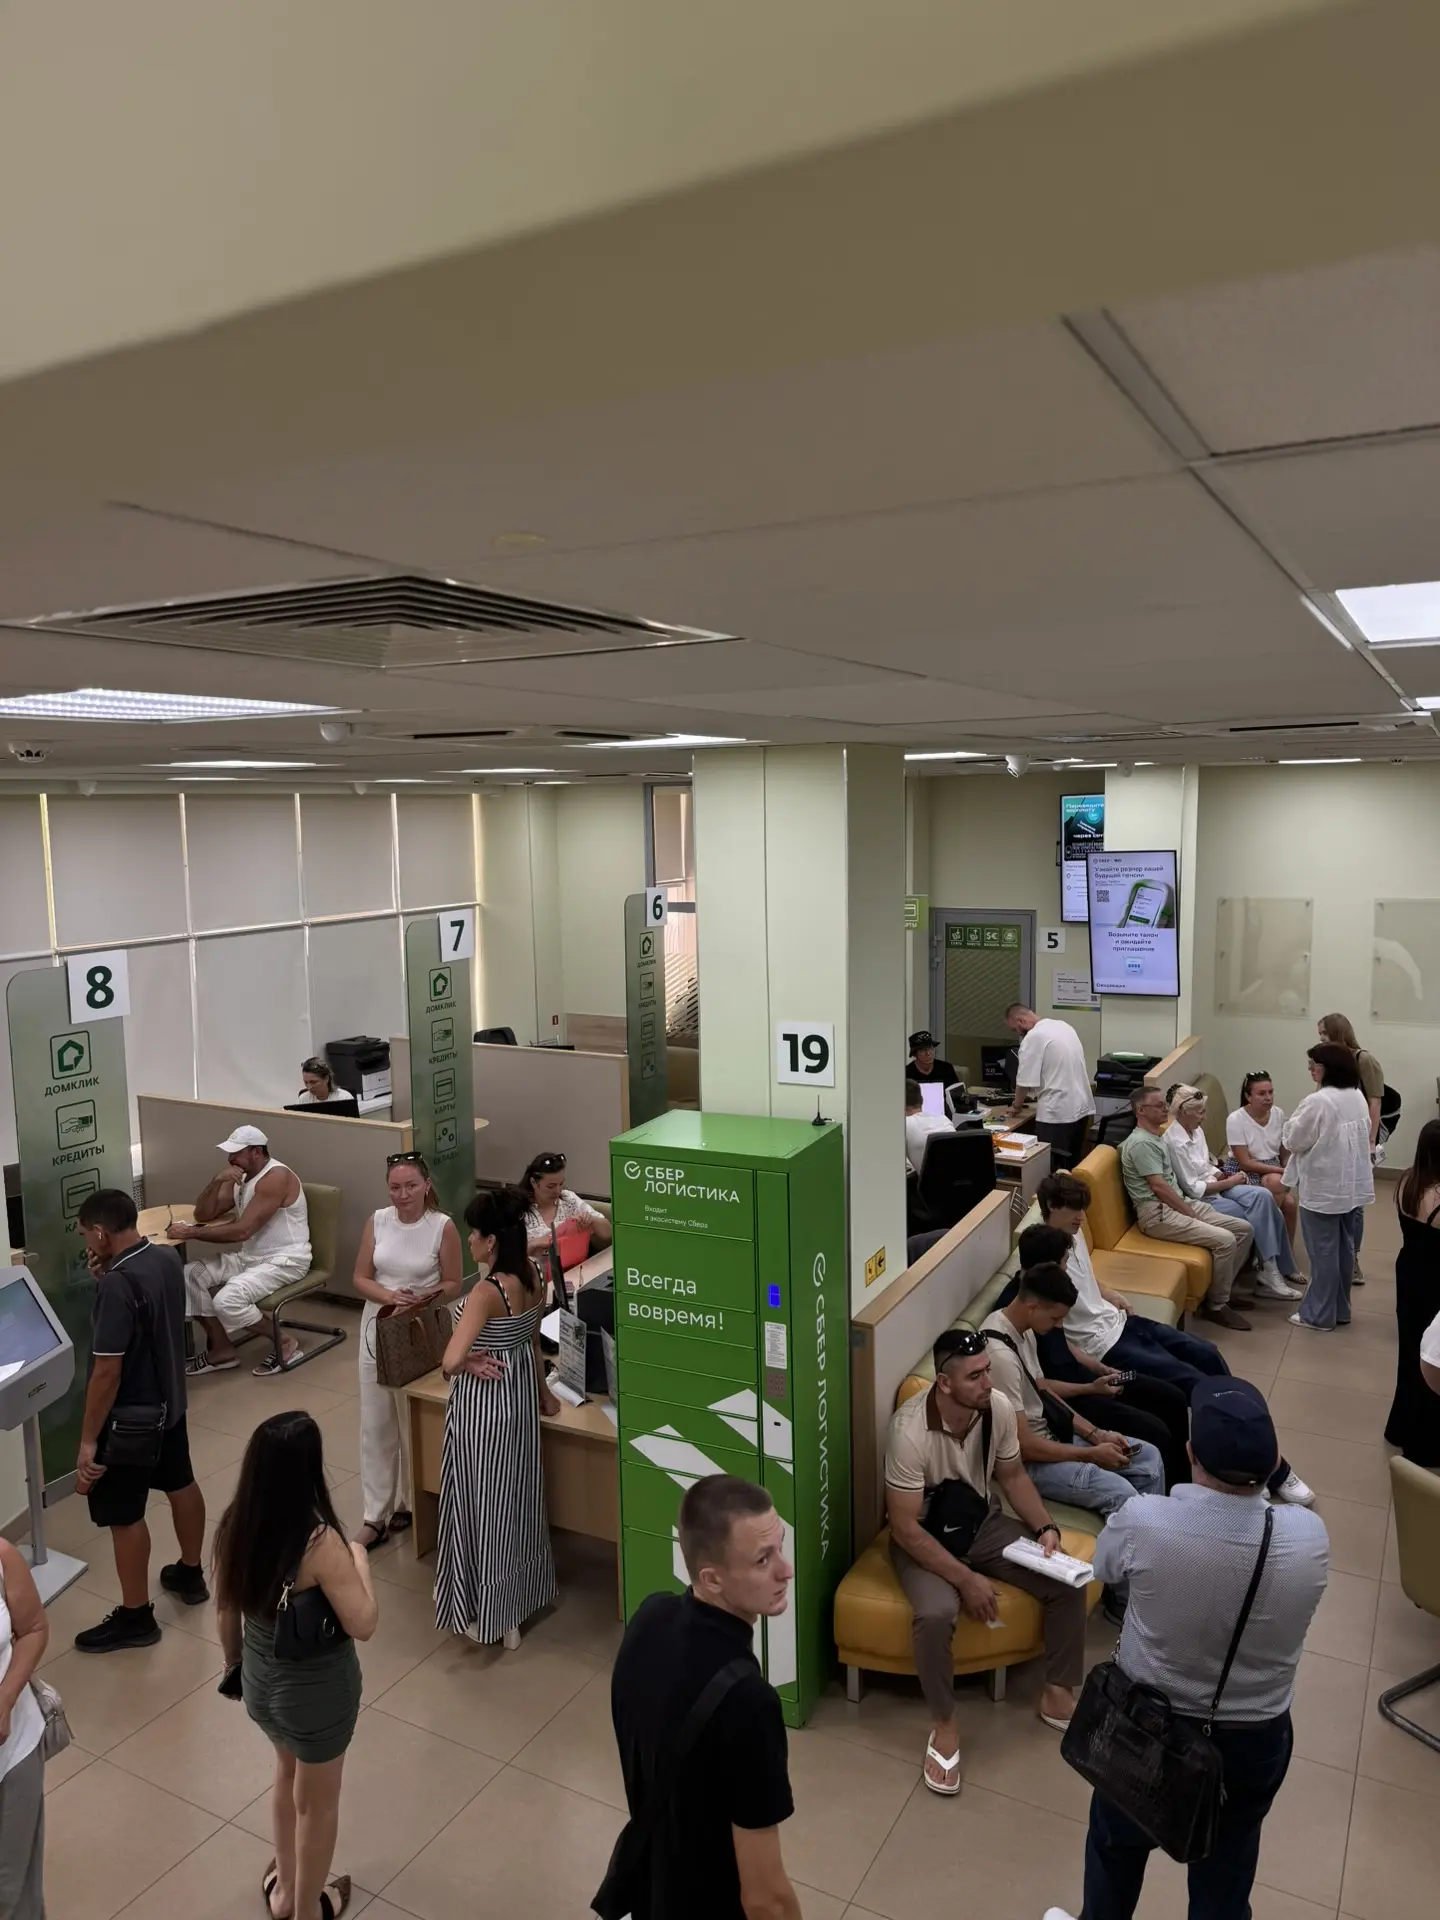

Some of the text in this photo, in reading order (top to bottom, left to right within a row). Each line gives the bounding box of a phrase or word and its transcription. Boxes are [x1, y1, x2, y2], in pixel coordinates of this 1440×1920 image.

[652, 894, 663, 920] 6
[449, 919, 465, 952] 7
[1047, 932, 1059, 949] 5
[86, 965, 115, 1010] 8
[425, 1001, 457, 1015] ДОМКЛИК
[428, 1050, 458, 1065] КРЕДИТЫ
[782, 1033, 830, 1074] 19
[44, 1075, 100, 1098] ДОМКЛИК
[52, 1144, 106, 1167] КРЕДИТЫ
[644, 1165, 685, 1182] СБЕР
[644, 1180, 740, 1204] ЛОГИСТИКА
[644, 1204, 668, 1214] Входит
[650, 1215, 687, 1227] экосистему
[688, 1219, 709, 1229] Сбера
[626, 1267, 697, 1295] Всегда
[628, 1302, 724, 1331] вовремя!
[816, 1294, 830, 1561] СБЕР ЛОГИСТИКА
